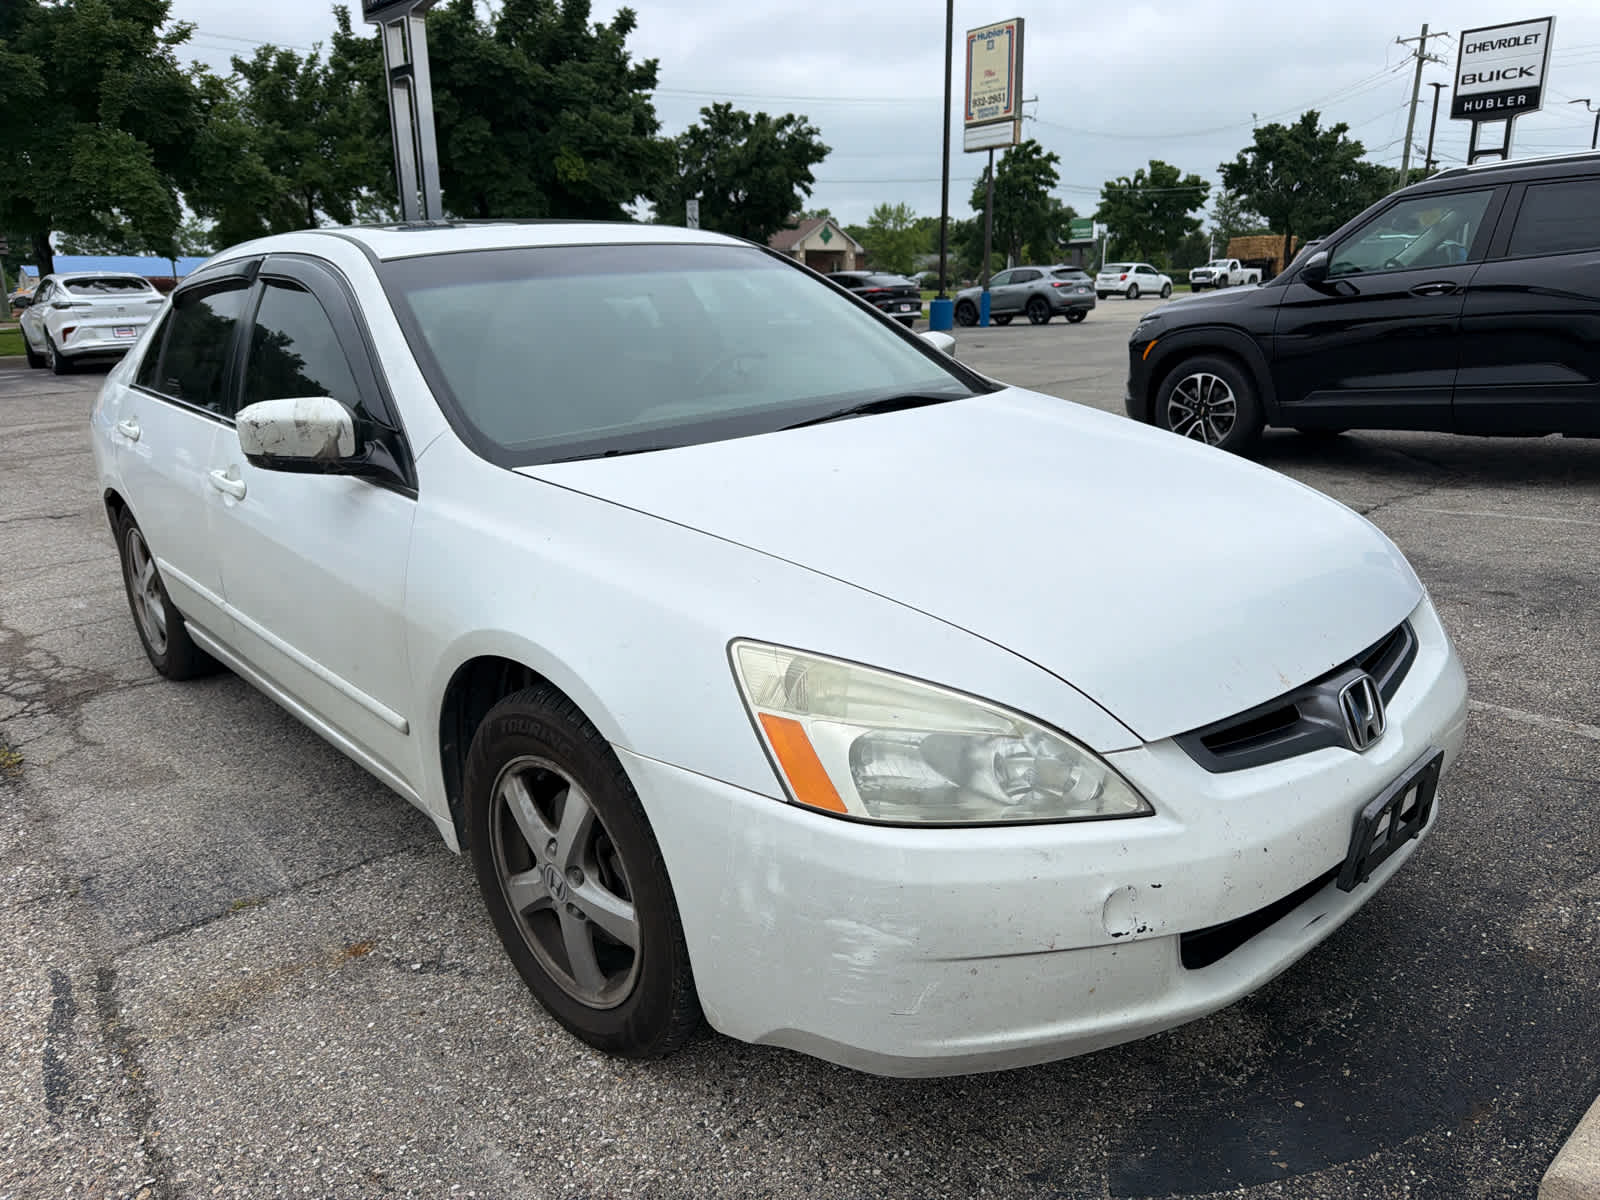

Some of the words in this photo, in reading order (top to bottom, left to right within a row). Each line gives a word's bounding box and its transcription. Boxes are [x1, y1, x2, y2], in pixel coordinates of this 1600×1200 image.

[1465, 33, 1541, 54] CHEVROLET
[1461, 65, 1536, 86] BUICK
[1463, 95, 1527, 112] HUBLER
